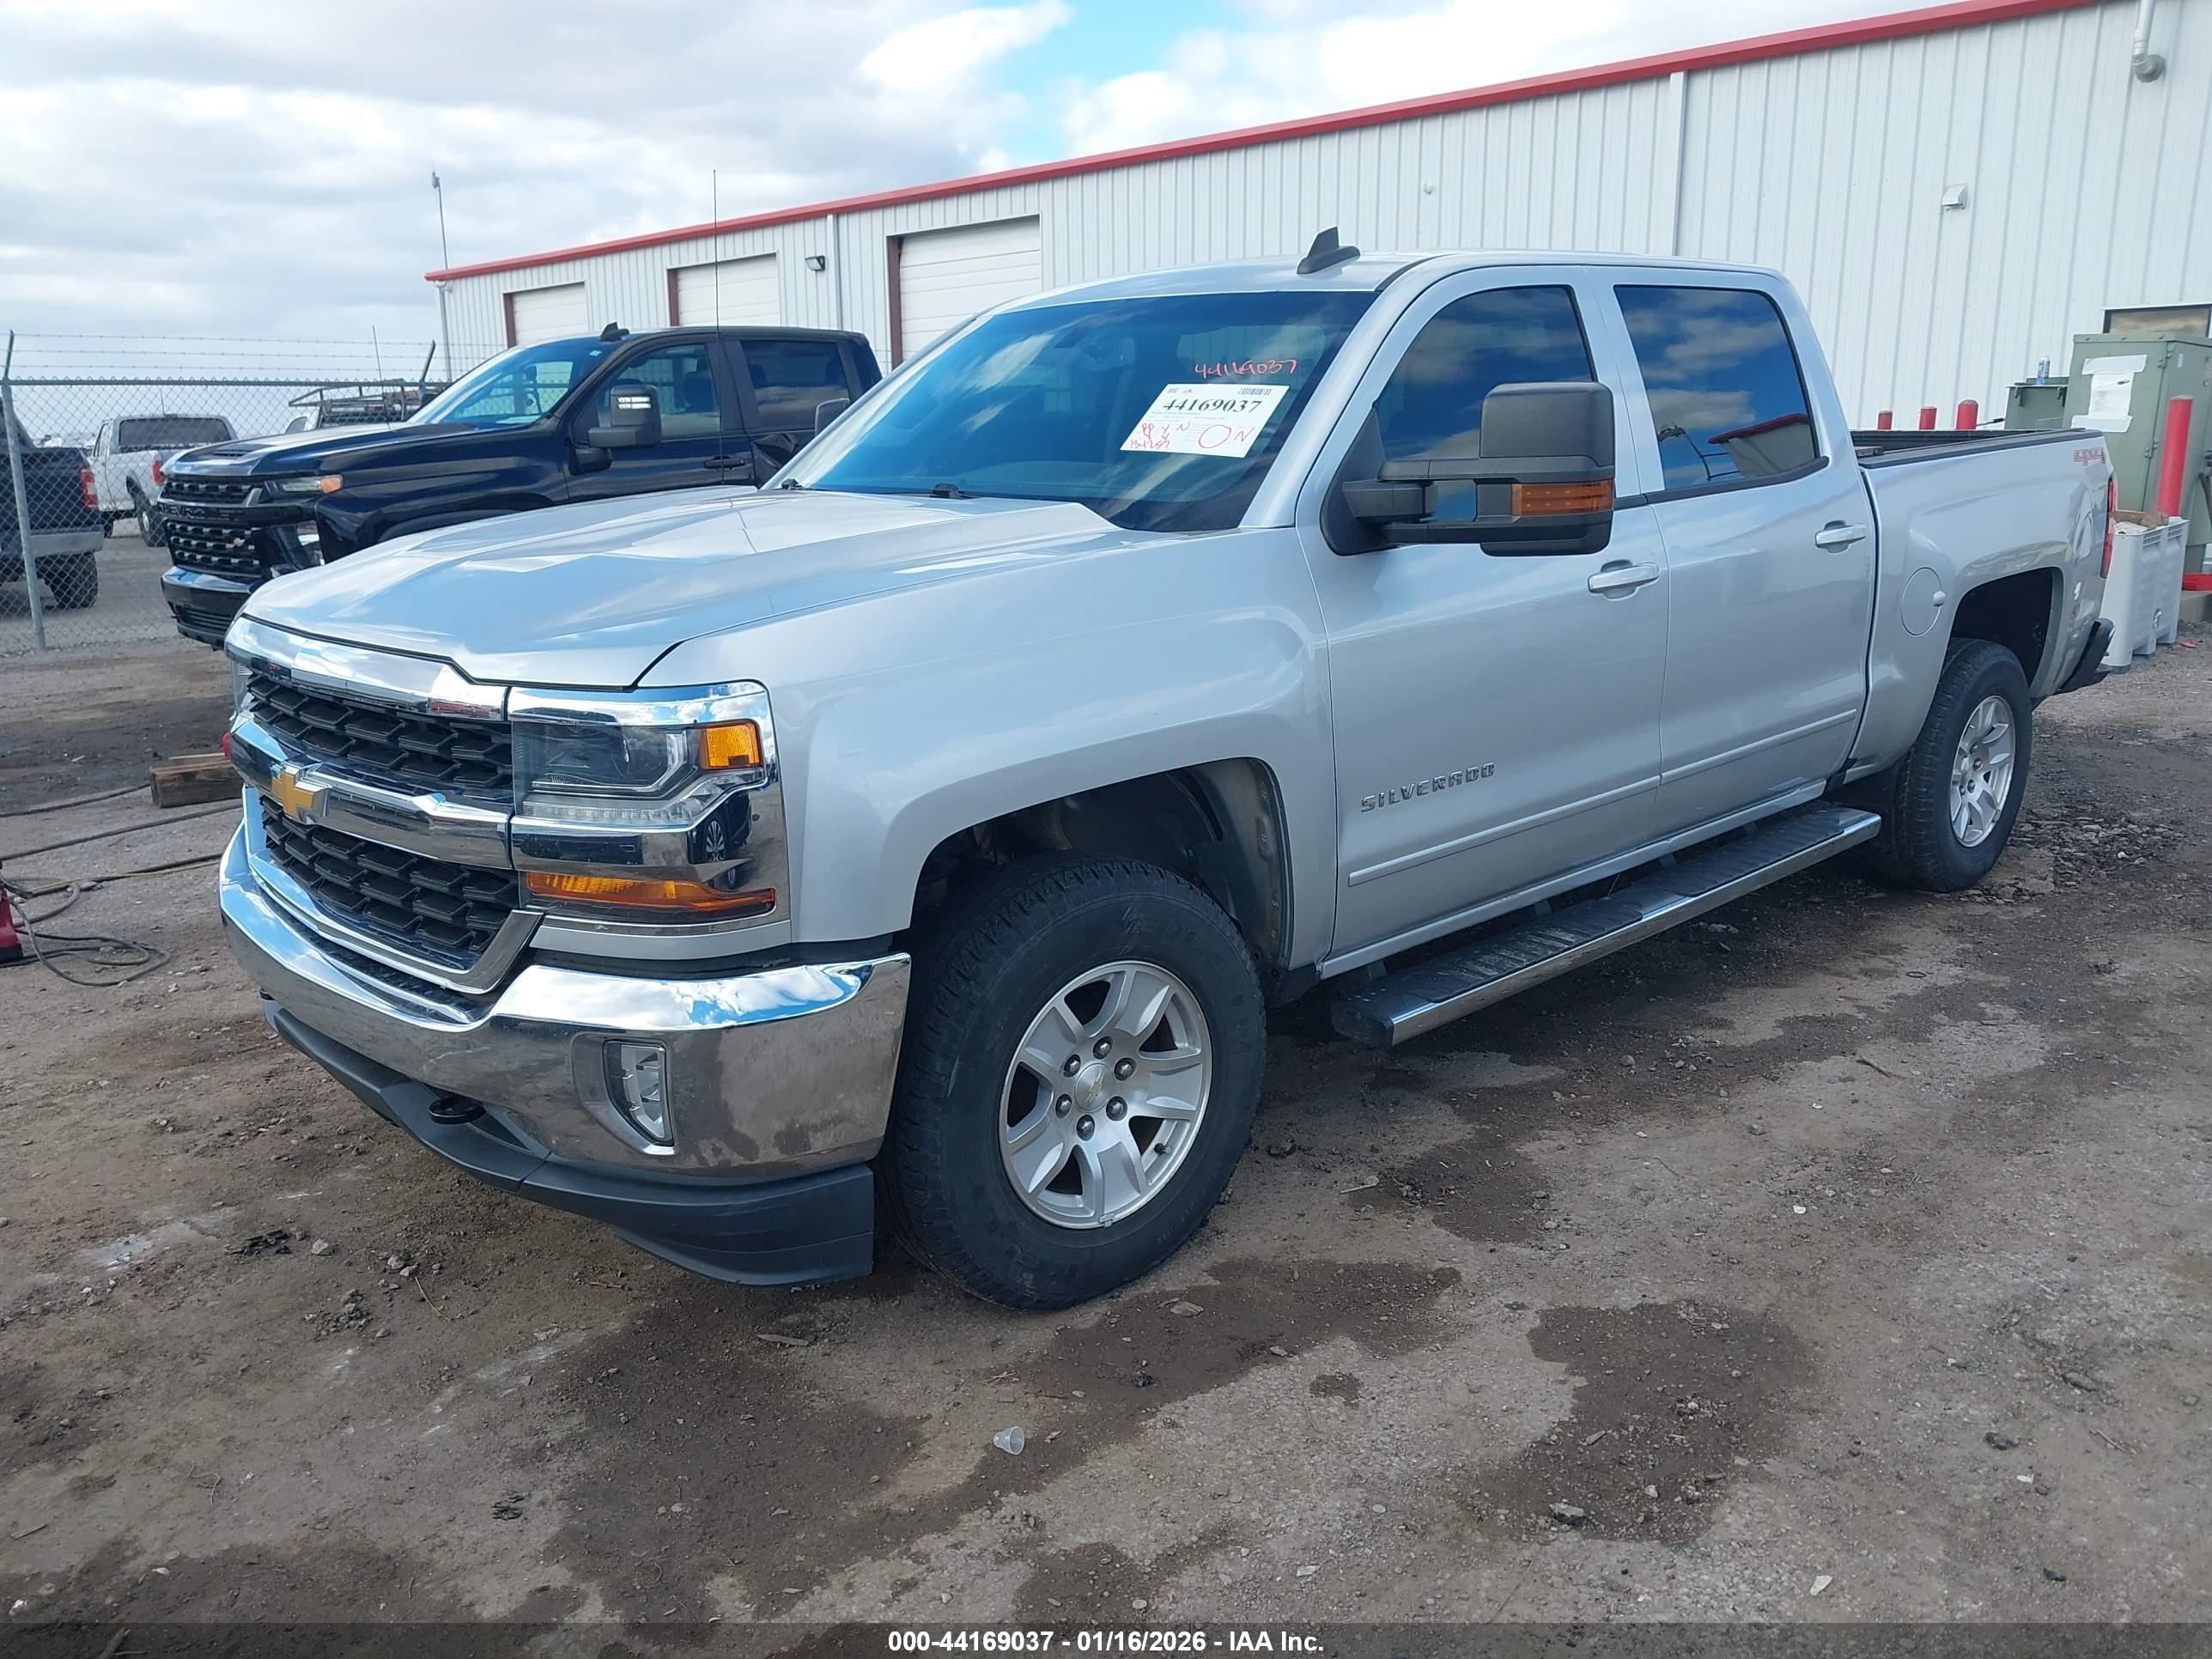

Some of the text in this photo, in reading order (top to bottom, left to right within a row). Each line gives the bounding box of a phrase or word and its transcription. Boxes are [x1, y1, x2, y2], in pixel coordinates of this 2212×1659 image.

[1194, 359, 1297, 379] 44169037
[1164, 398, 1262, 413] 44169037
[1360, 762, 1495, 812] SILVERADO
